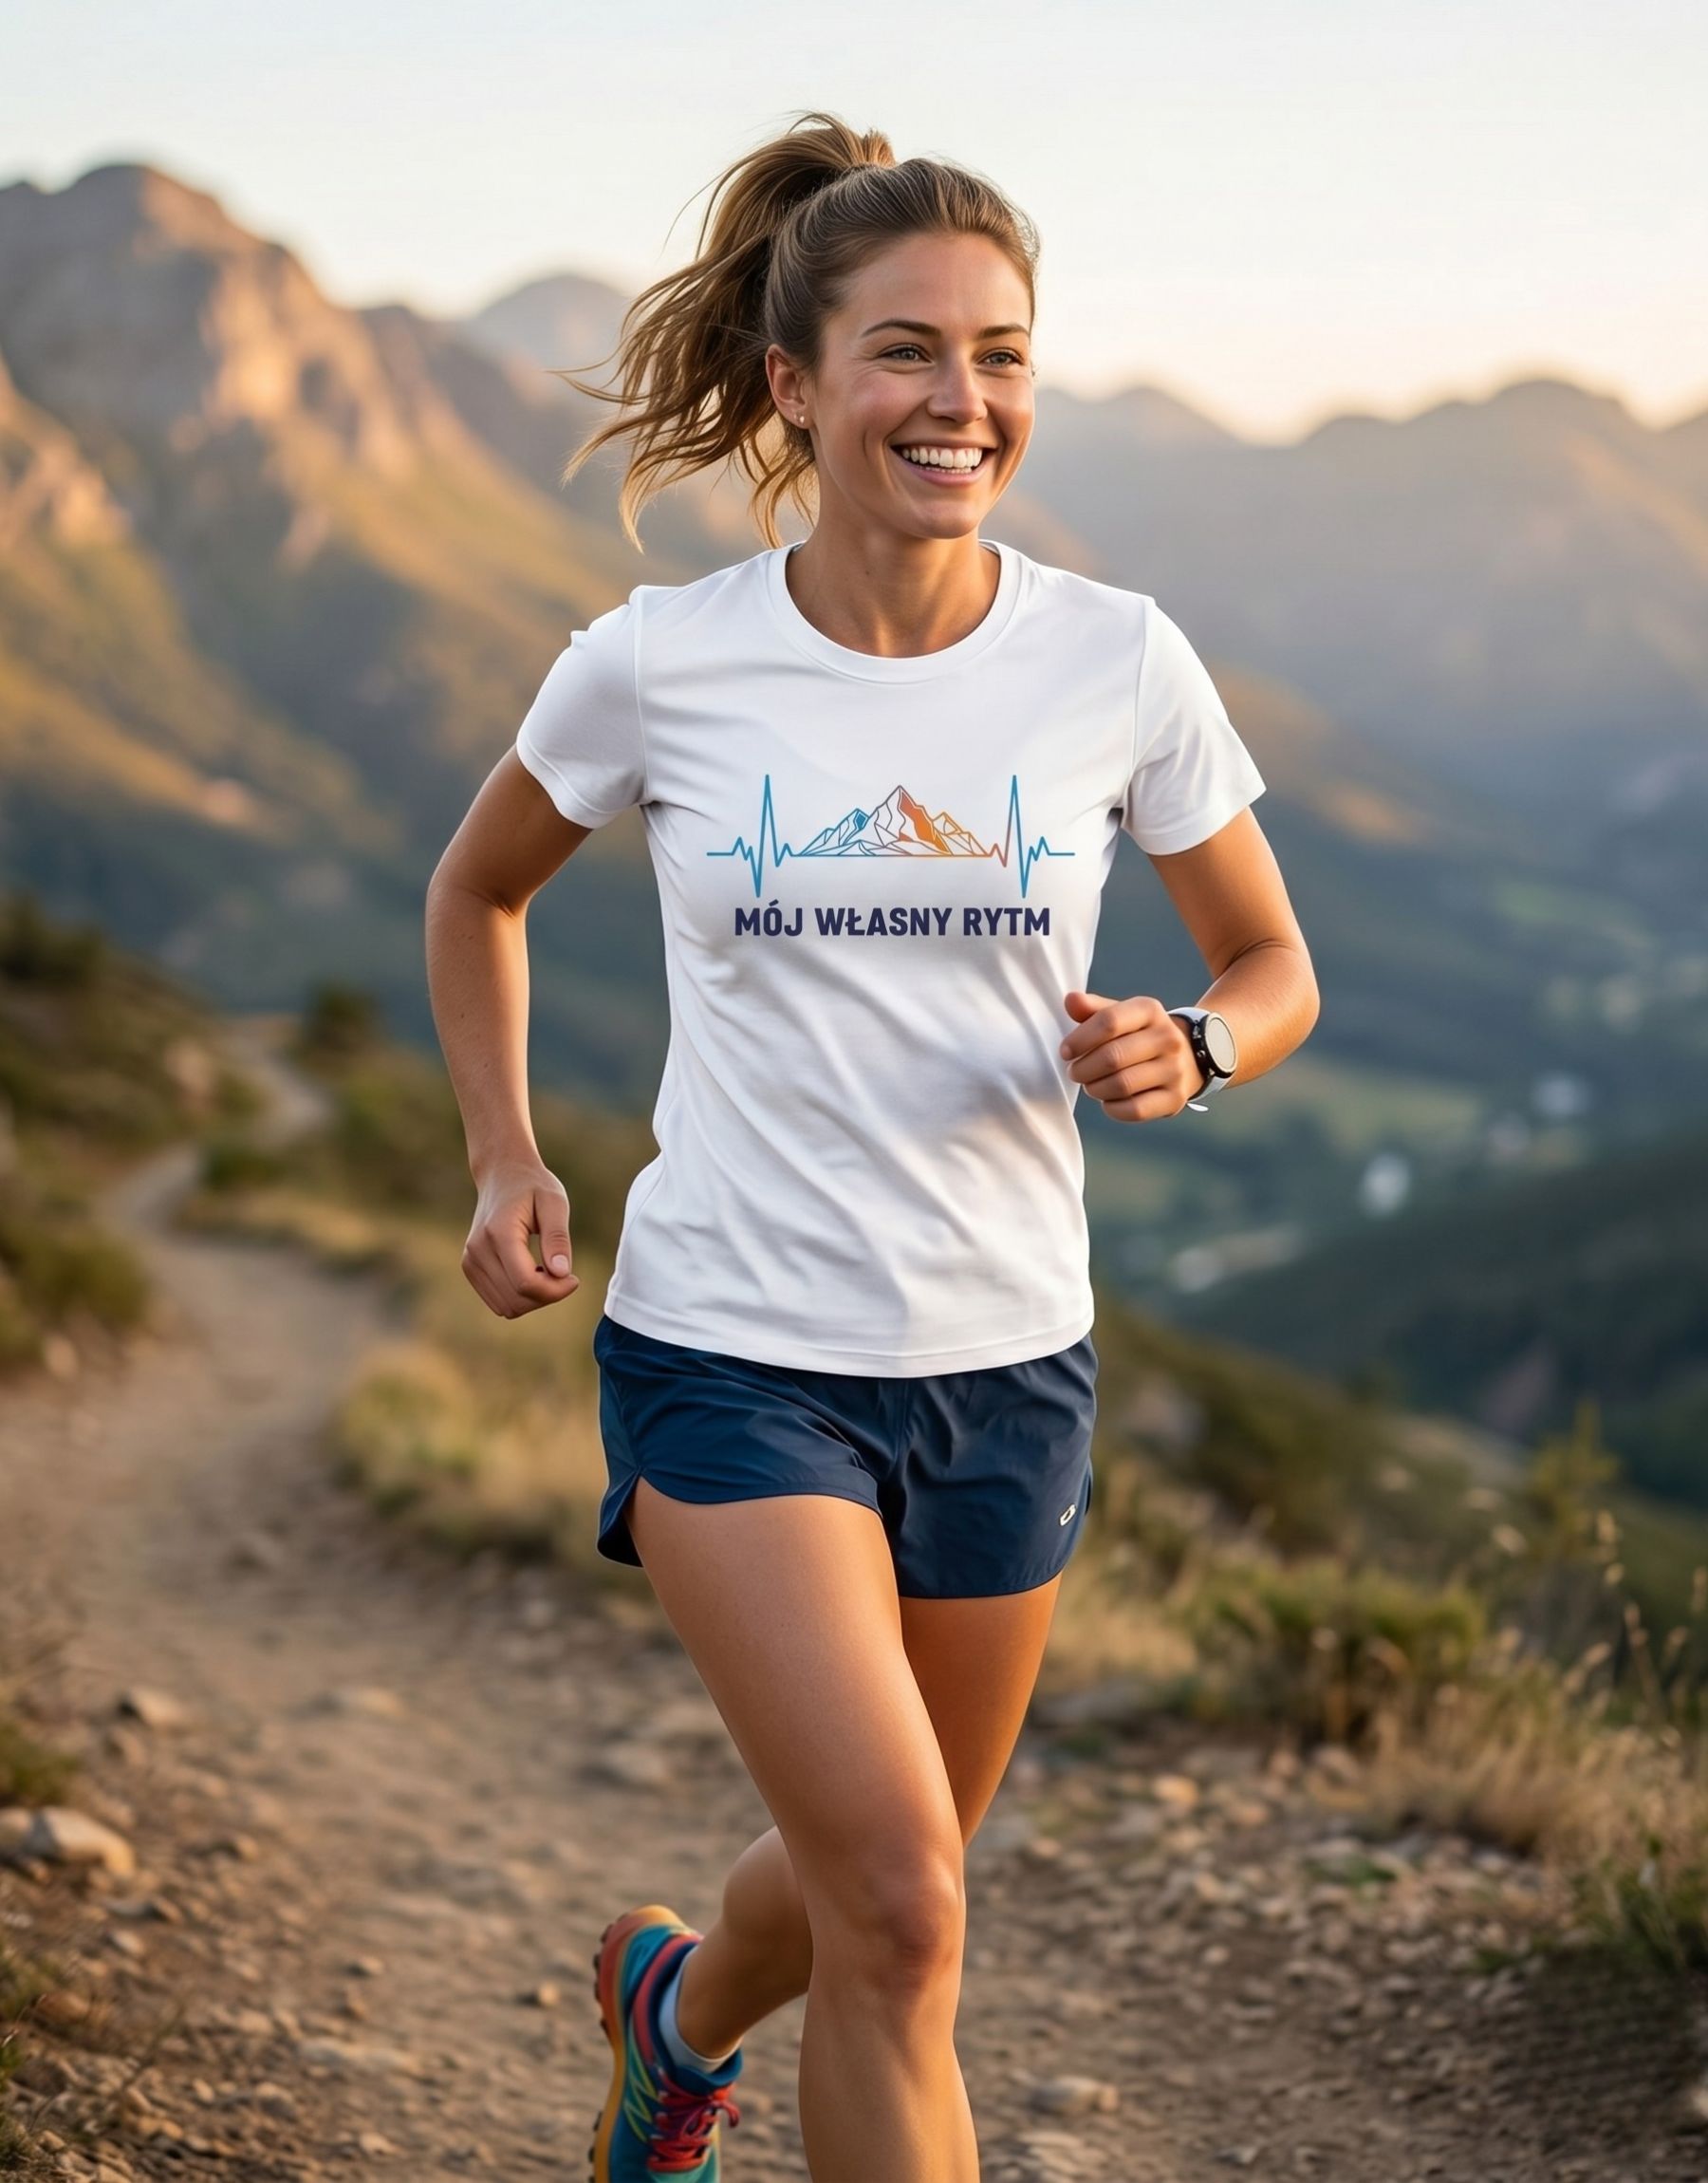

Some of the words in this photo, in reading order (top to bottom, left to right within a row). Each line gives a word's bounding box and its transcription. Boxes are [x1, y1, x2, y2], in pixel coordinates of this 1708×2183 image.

[734, 899, 804, 937] MÓJ
[814, 907, 953, 937] WŁASNY
[963, 907, 1050, 937] RYTM
